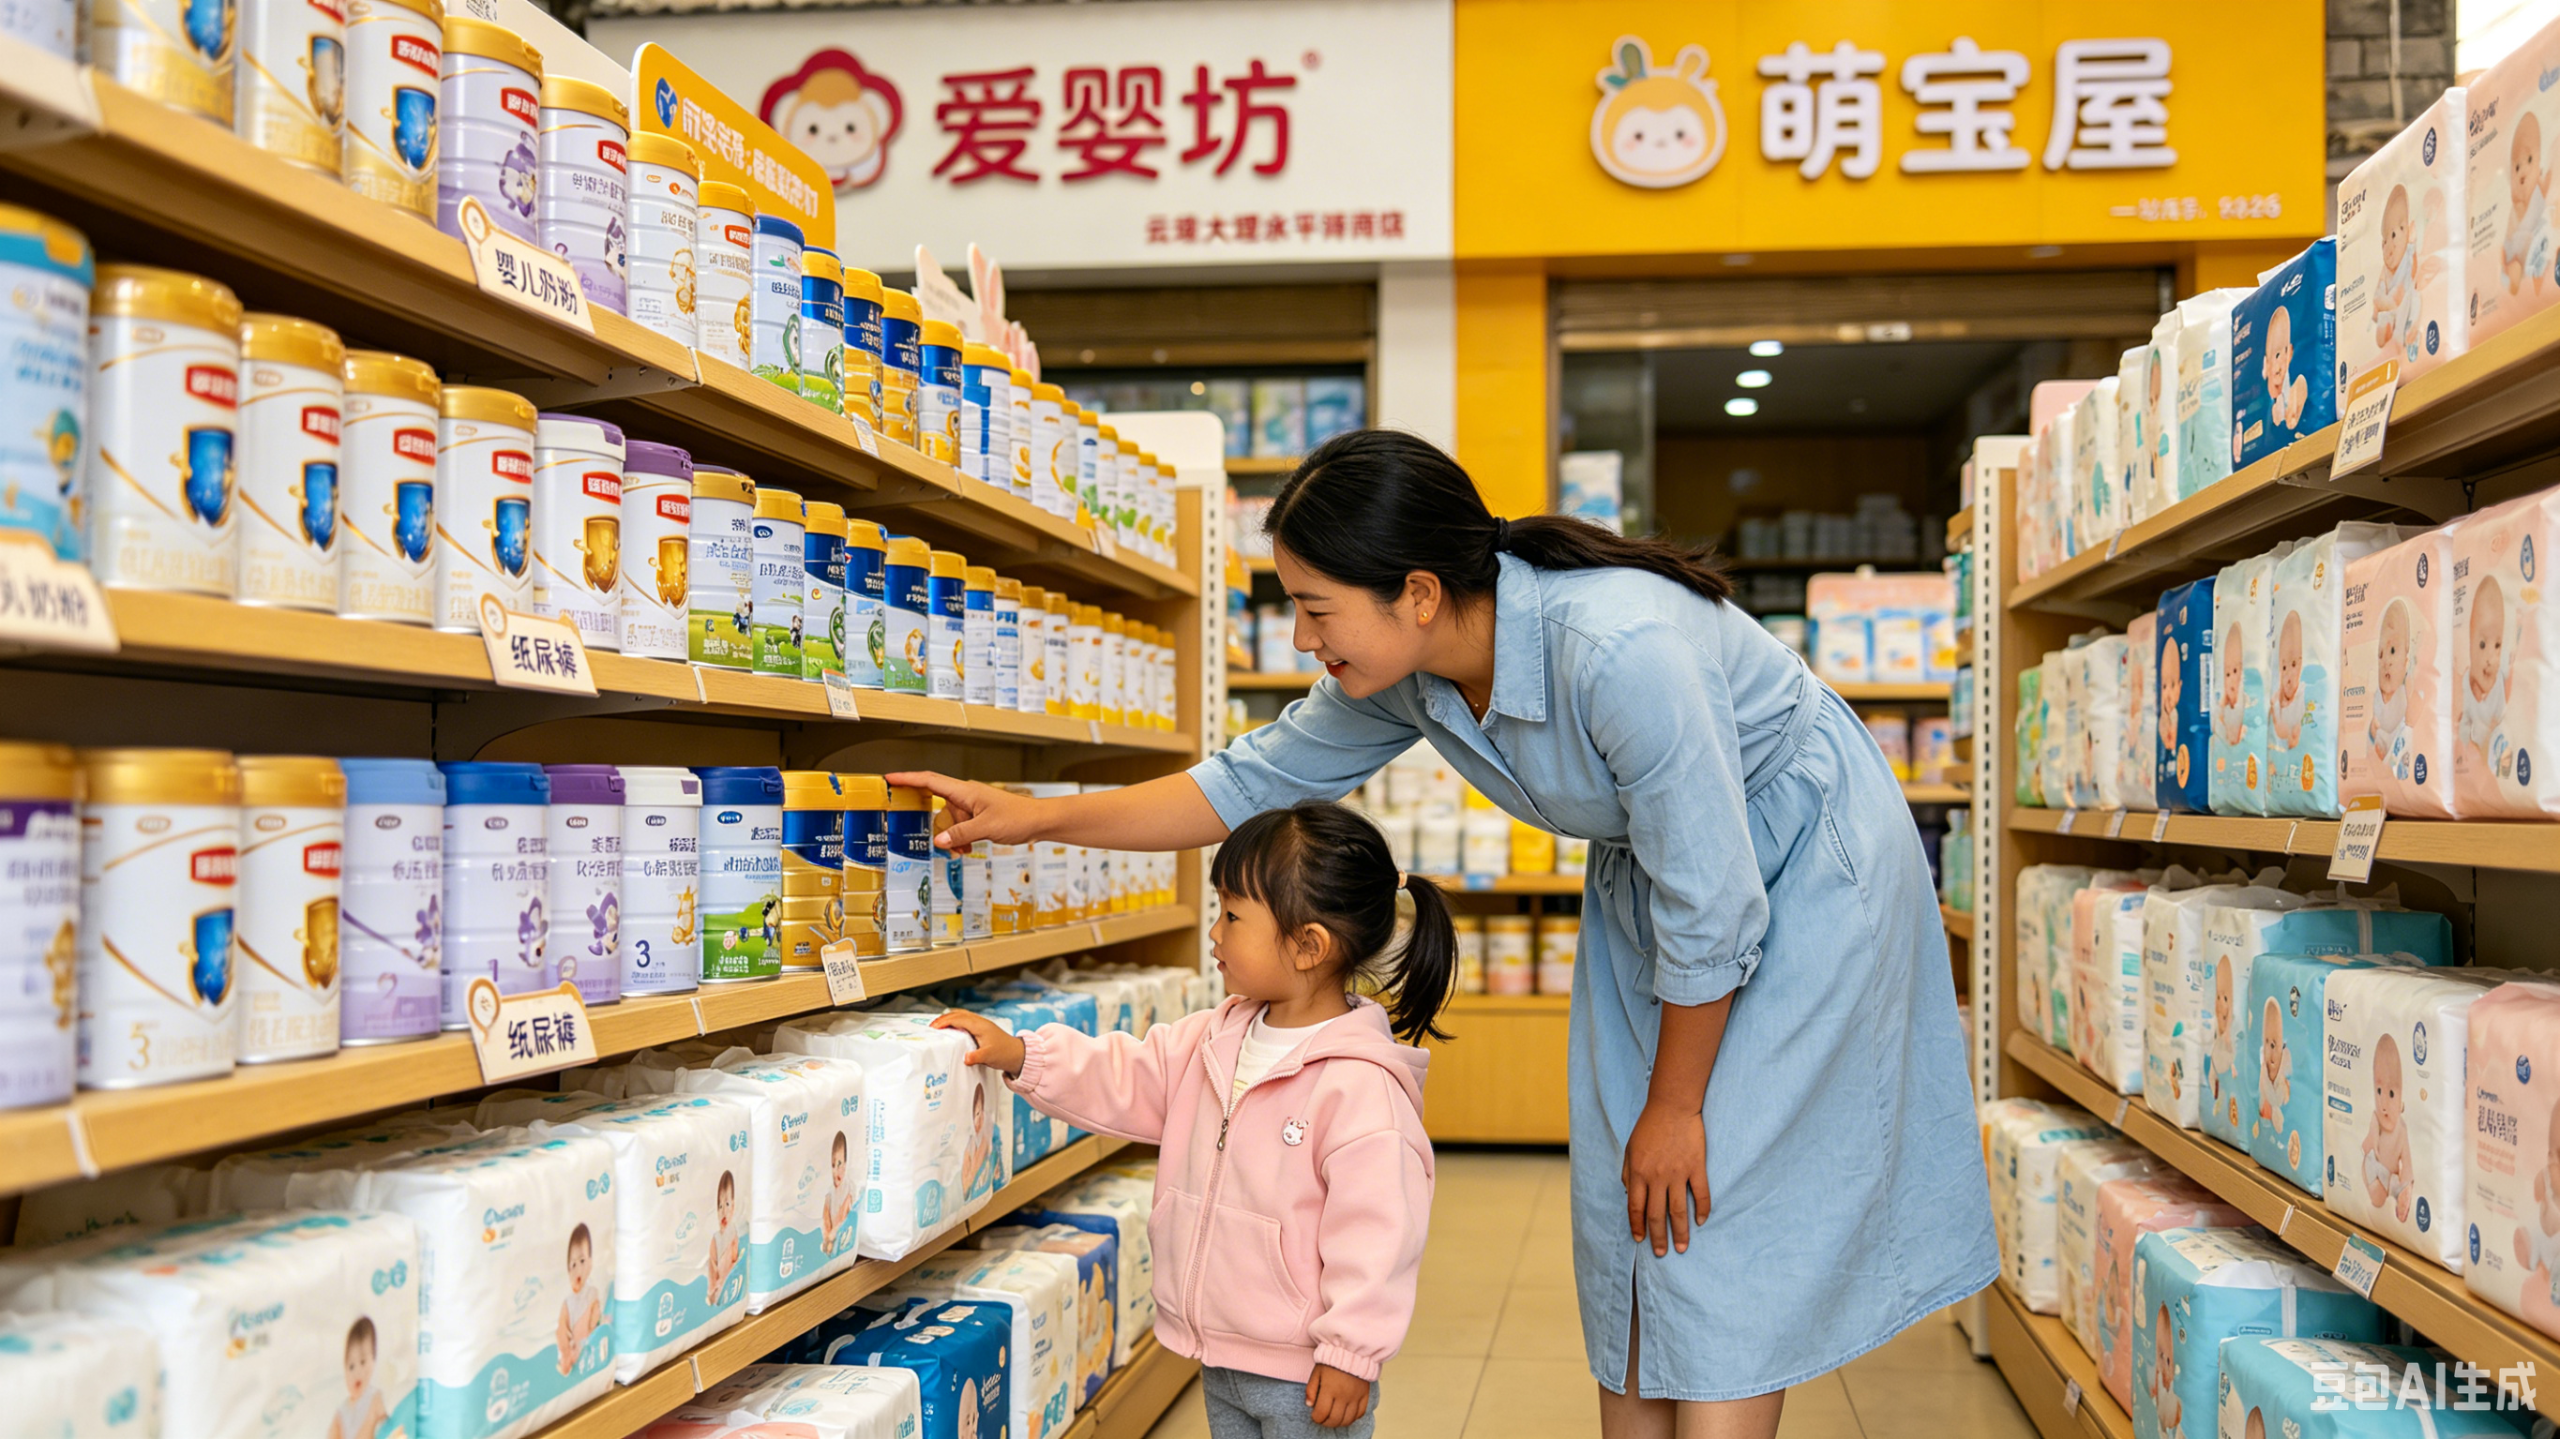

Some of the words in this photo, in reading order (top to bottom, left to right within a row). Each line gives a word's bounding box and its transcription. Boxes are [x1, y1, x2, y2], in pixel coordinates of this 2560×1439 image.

[932, 60, 1297, 184] 爱婴坊
[1758, 36, 2178, 180] 萌宝屋
[511, 634, 578, 679] 纸尿裤
[635, 939, 651, 968] 3
[508, 1012, 577, 1060] 纸尿裤
